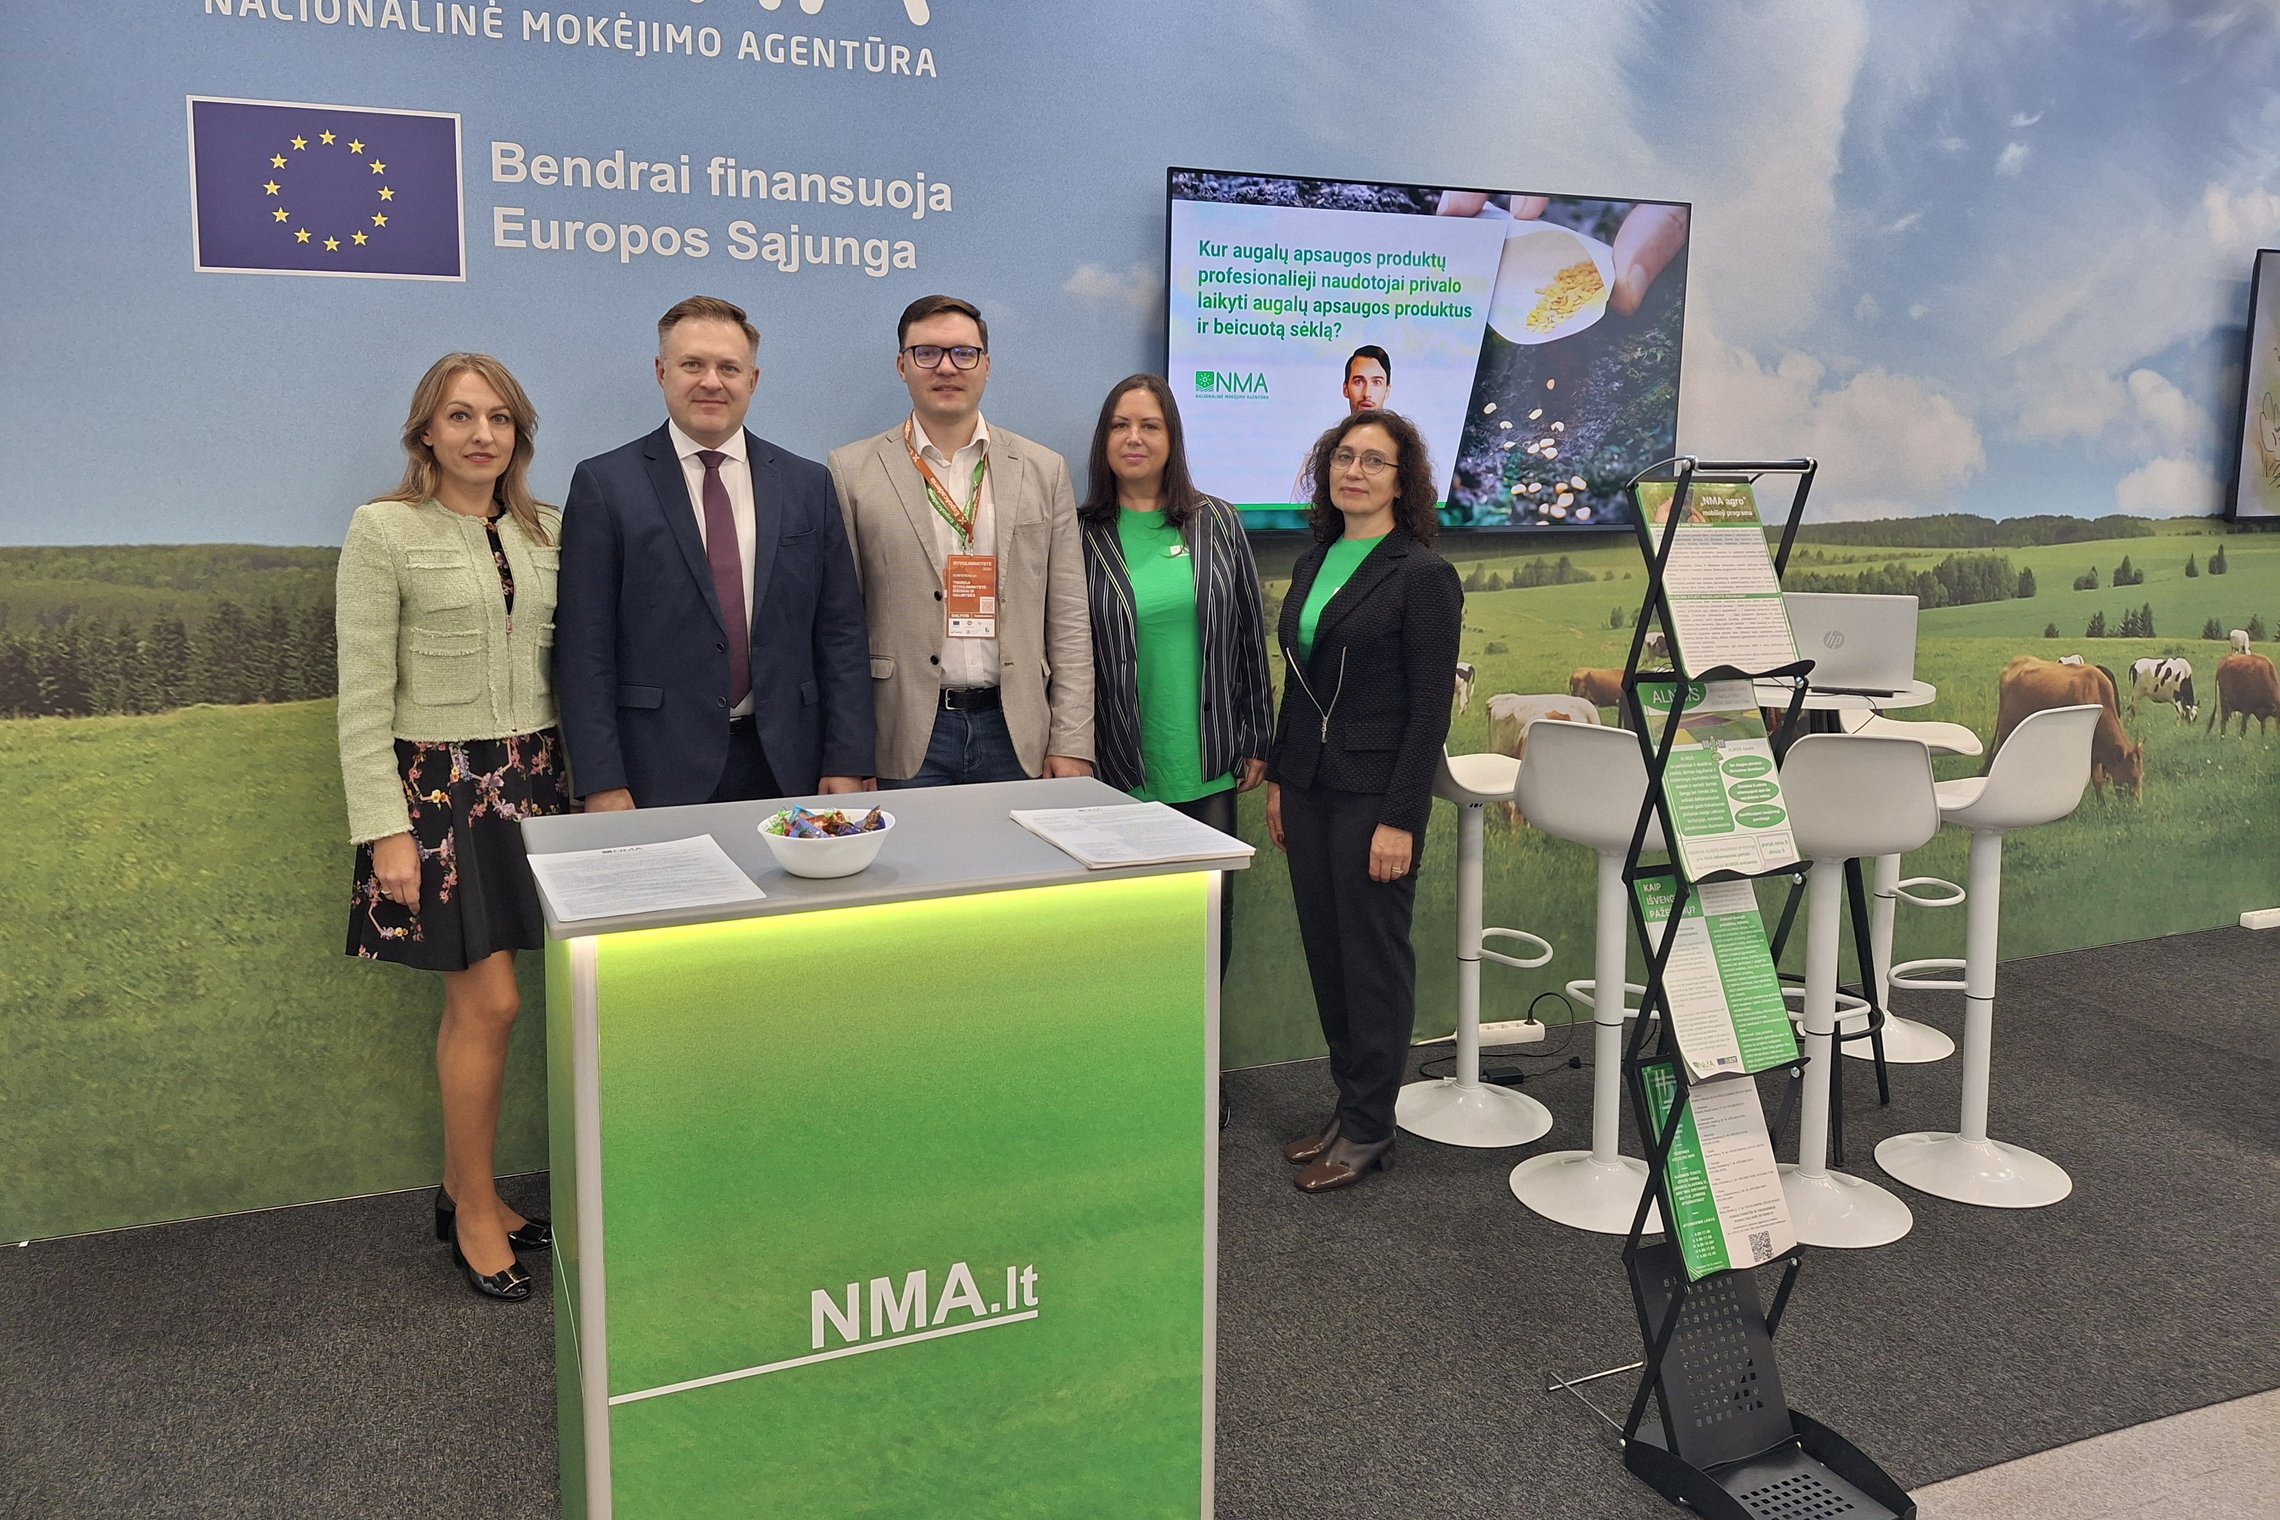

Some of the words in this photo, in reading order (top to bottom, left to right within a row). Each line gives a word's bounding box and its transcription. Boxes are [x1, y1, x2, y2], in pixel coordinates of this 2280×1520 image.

[522, 10, 722, 57] MOKĖJIMO
[737, 30, 937, 78] AGENTŪRA
[491, 141, 690, 194] Bendrai
[706, 156, 953, 220] finansuoja
[493, 206, 711, 264] Europos
[727, 220, 917, 278] Sąjunga
[1199, 239, 1228, 257] Kur
[1233, 243, 1288, 265] augalų
[1294, 248, 1372, 268] apsaugos
[1376, 250, 1446, 272] produktų
[1198, 266, 1316, 291] profesionalieji
[1321, 272, 1405, 295] naudotojai
[1409, 276, 1461, 296] privalo
[1197, 291, 1248, 314] laikyti
[1253, 295, 1308, 316] augalų
[1313, 300, 1390, 318] apsaugos
[1394, 300, 1473, 320] produktus
[1197, 317, 1209, 334] ir
[1213, 317, 1285, 340] beicuotą
[1290, 320, 1342, 341] sėklą?
[1216, 371, 1268, 393] NMA
[1825, 630, 1843, 649] hp
[1653, 687, 1700, 704] ALNIS
[1643, 883, 1661, 893] KAIP
[1646, 894, 1675, 905] IŠVENG
[811, 1261, 1039, 1350] NMA.lt
